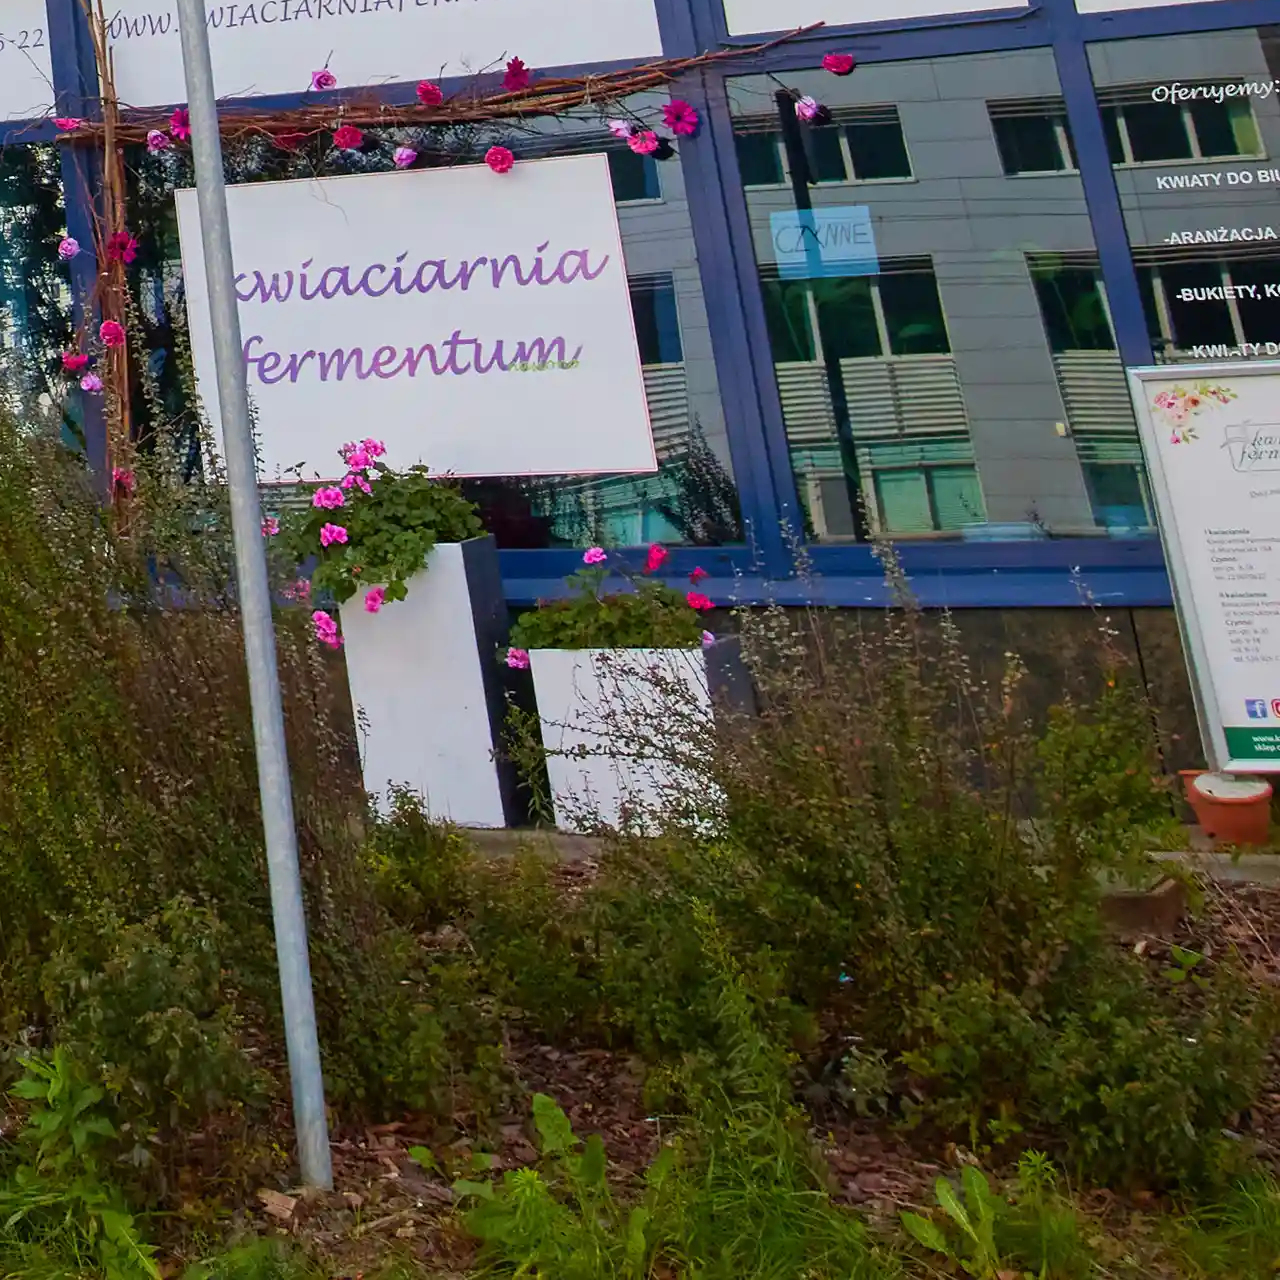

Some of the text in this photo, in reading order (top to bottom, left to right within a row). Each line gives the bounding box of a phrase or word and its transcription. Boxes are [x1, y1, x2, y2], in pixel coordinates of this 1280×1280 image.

[1156, 172, 1223, 190] KWIATY
[1226, 170, 1254, 186] DO
[775, 222, 873, 254] CZYNNE
[1164, 225, 1278, 245] -ARANŻACJA
[1175, 283, 1263, 303] -BUKIETY,
[242, 328, 584, 385] fermentum
[1265, 342, 1280, 355] D
